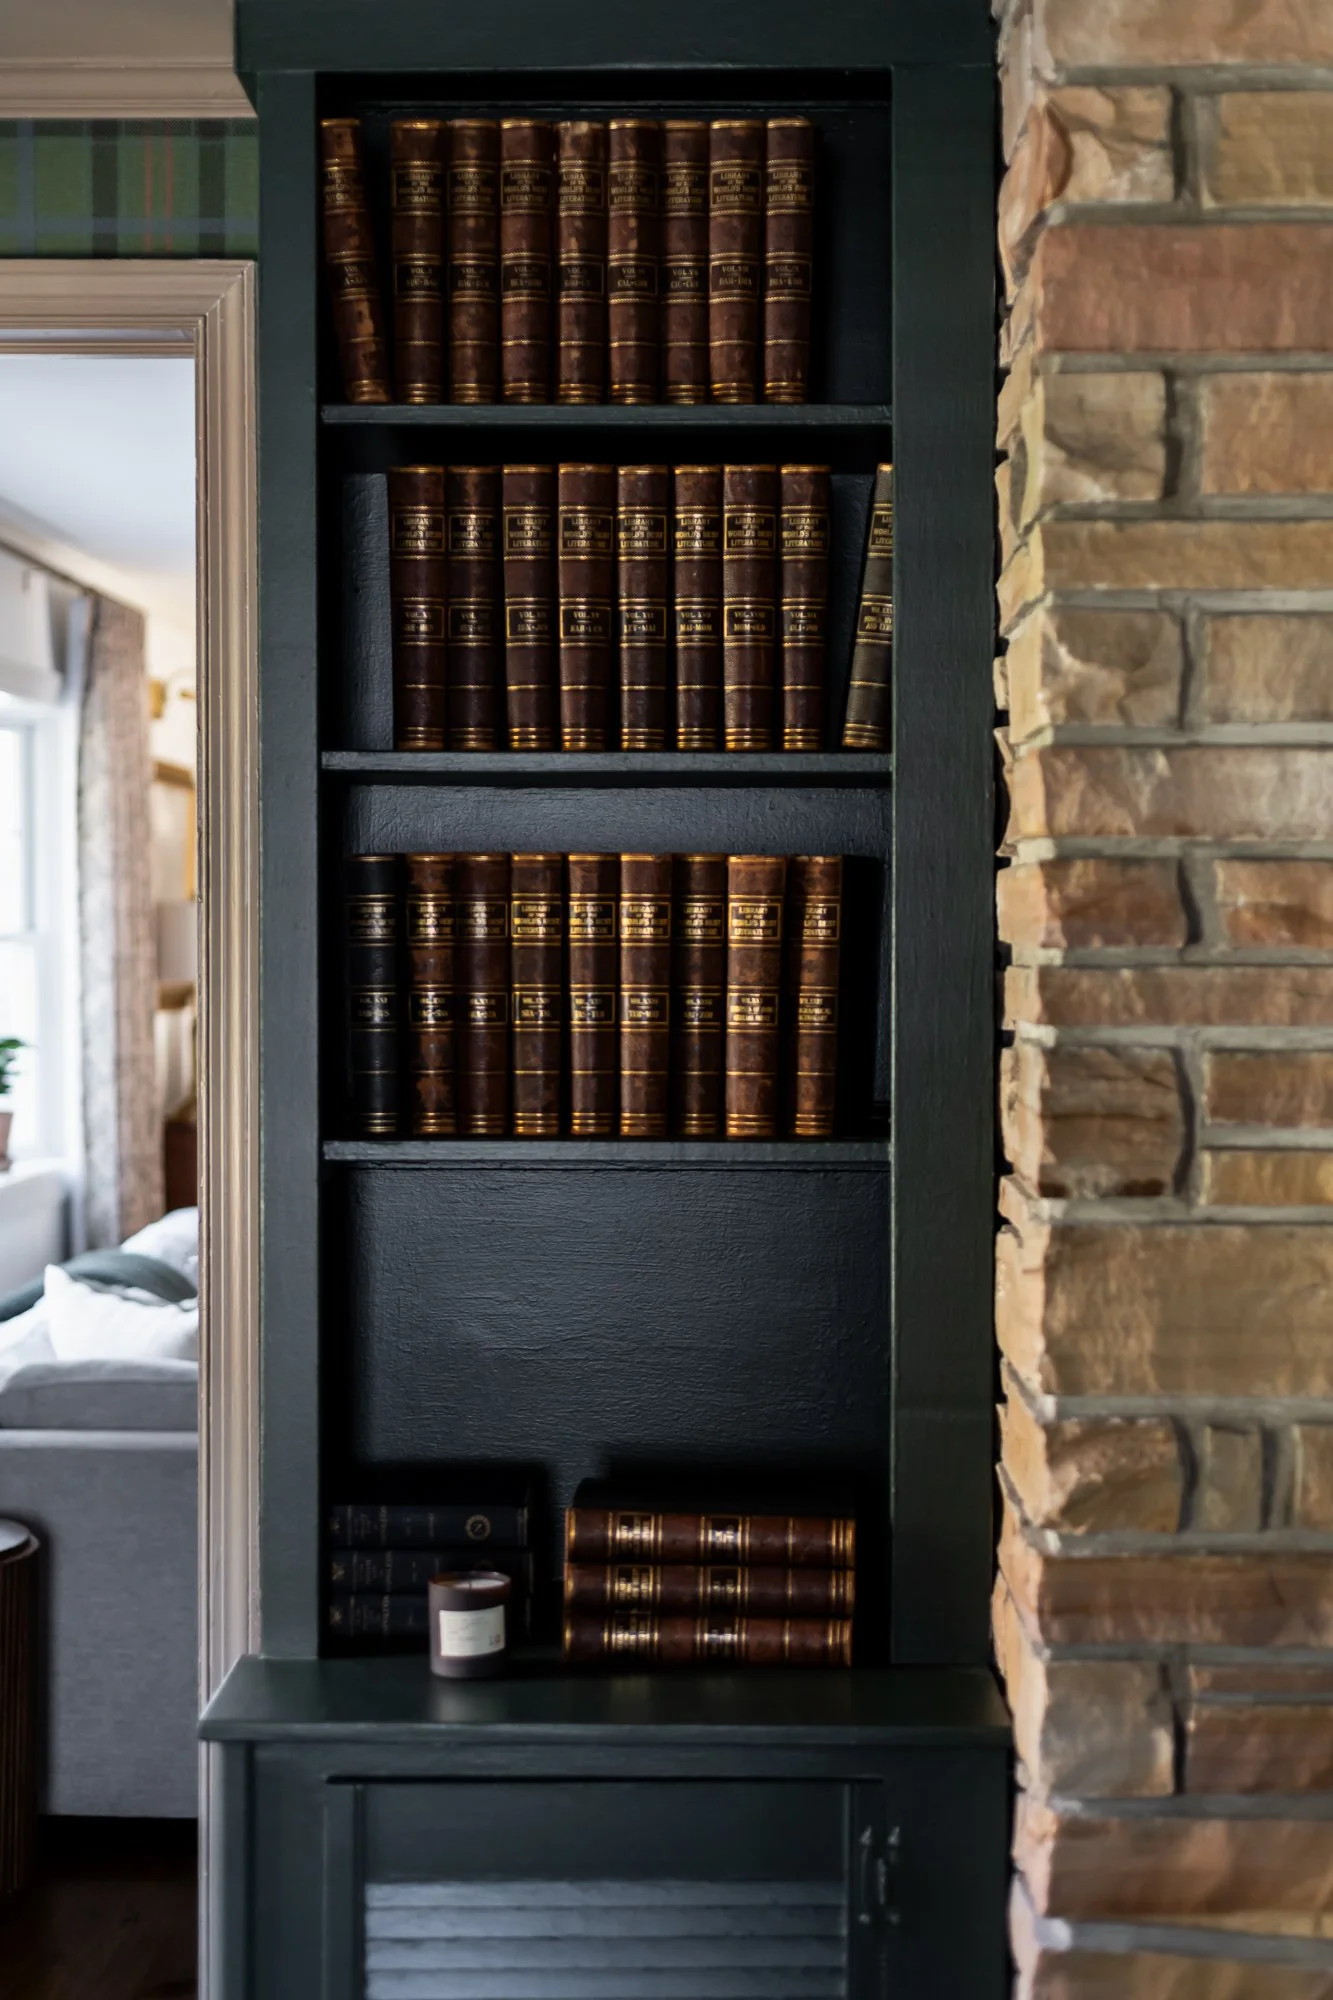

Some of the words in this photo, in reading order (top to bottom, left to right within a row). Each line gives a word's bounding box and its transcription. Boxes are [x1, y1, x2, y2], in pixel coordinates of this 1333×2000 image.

[517, 518, 547, 526] LIBRARY
[624, 518, 654, 526] LIBRARY
[681, 518, 710, 526] LIBRARY
[735, 516, 764, 525] LIBRARY
[789, 517, 819, 525] LIBRARY
